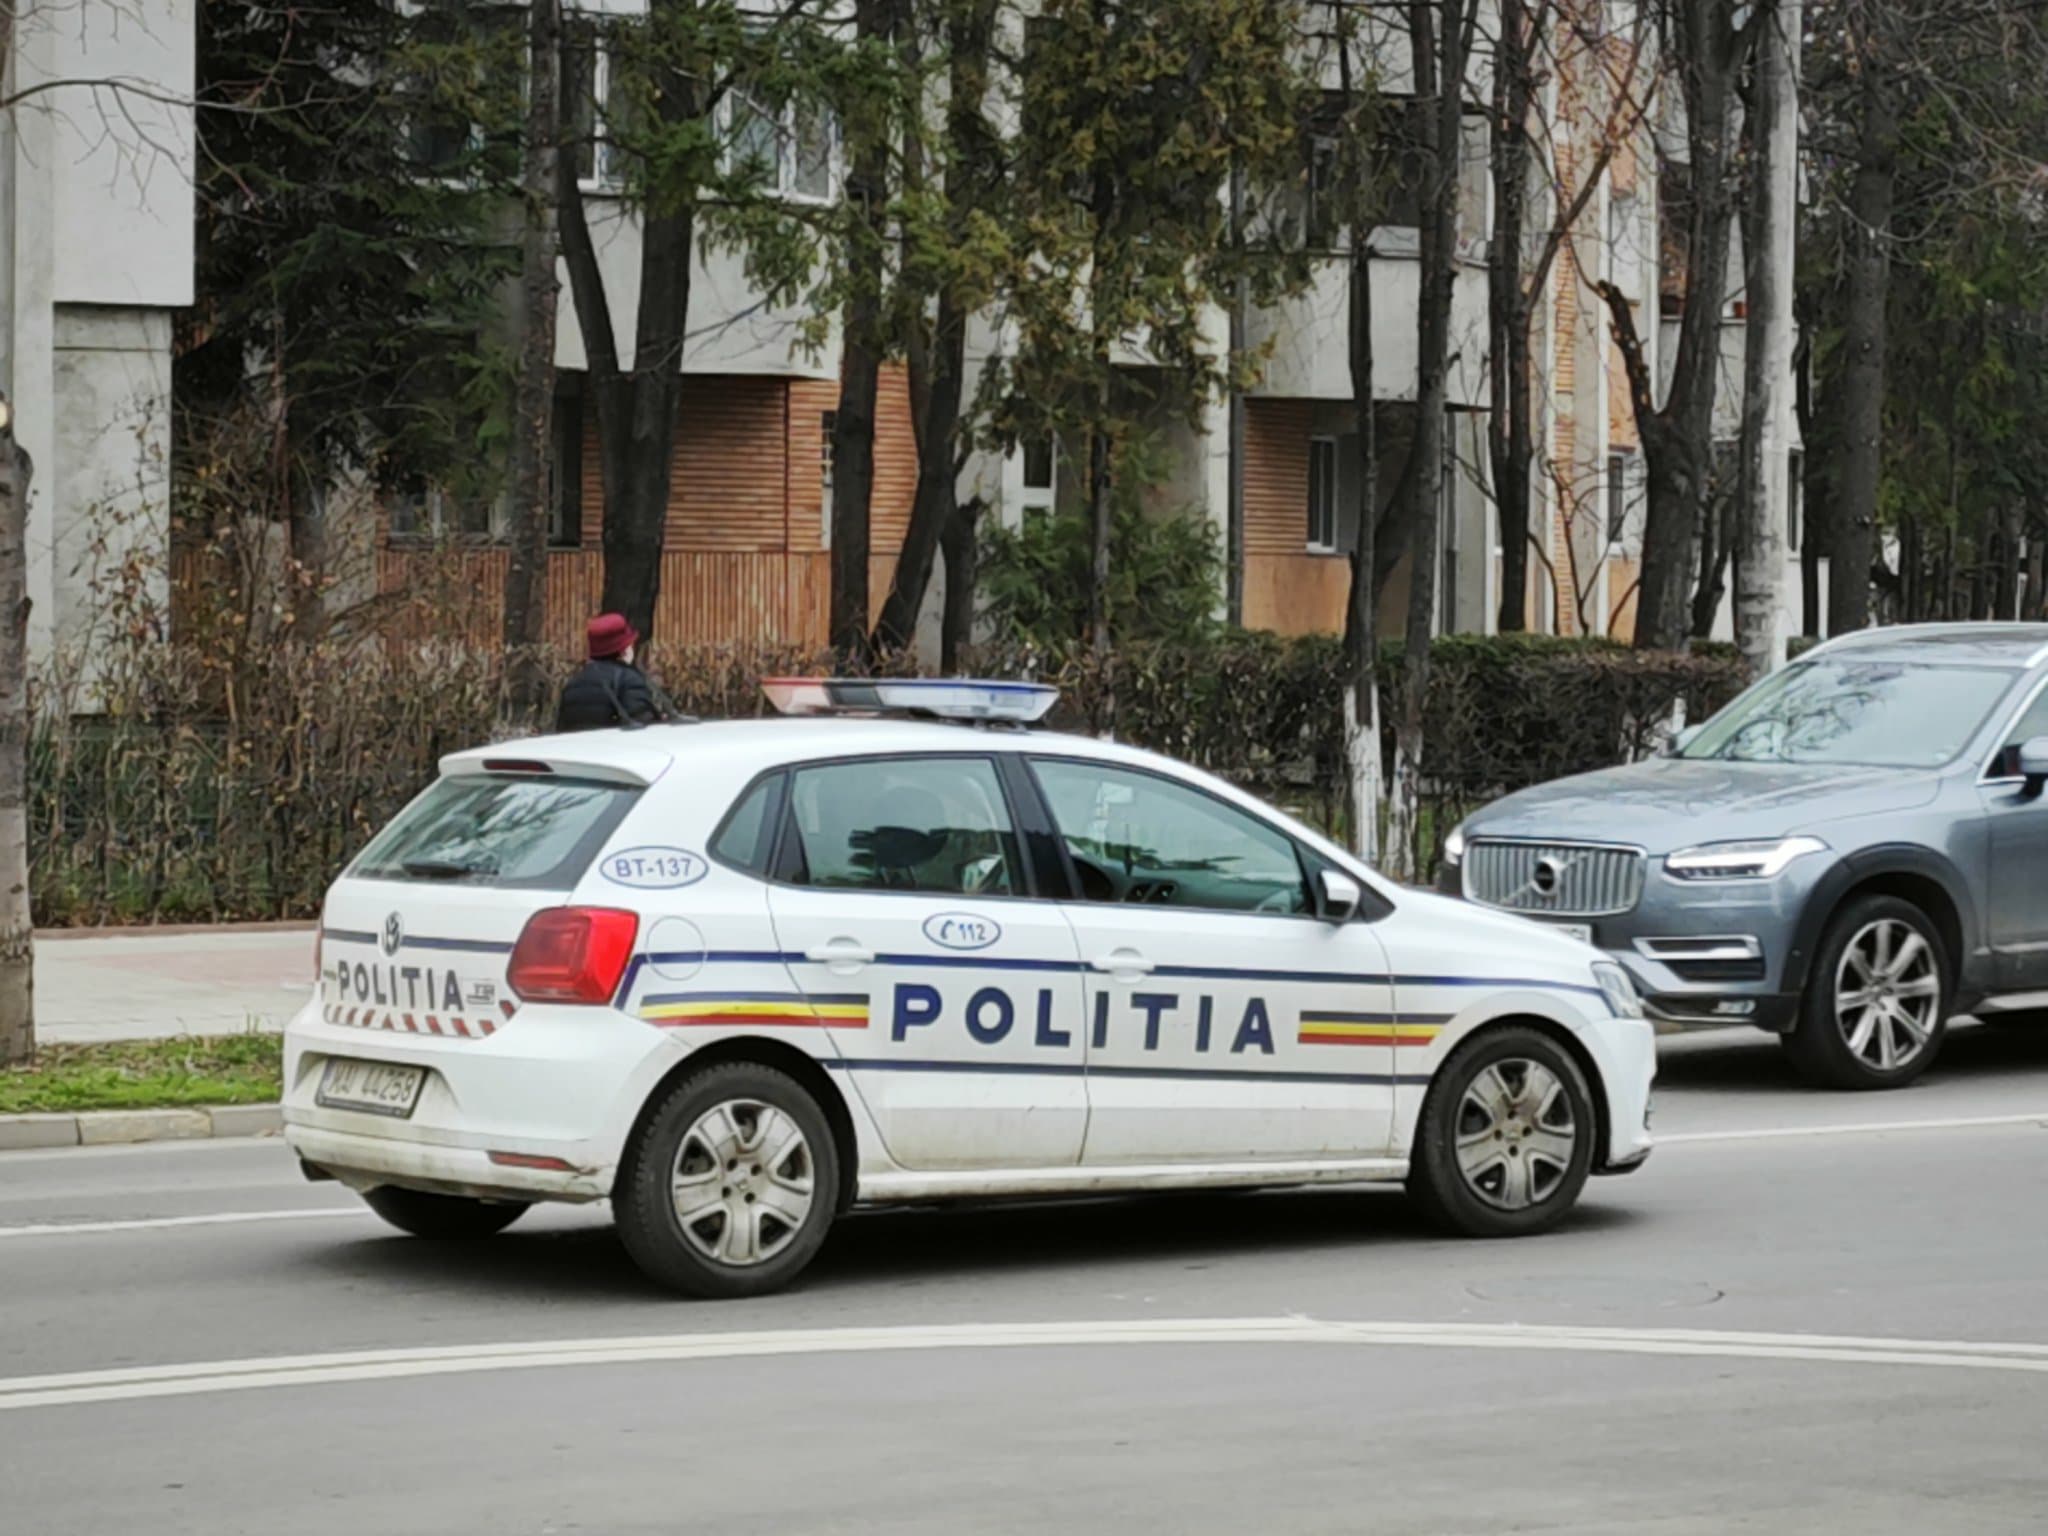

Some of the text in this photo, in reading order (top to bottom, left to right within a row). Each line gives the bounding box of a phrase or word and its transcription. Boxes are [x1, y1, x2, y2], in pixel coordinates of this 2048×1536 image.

[615, 858, 691, 877] BT-137
[959, 923, 986, 941] 112
[338, 959, 465, 1012] POLITIA
[891, 983, 1275, 1055] POLITIA
